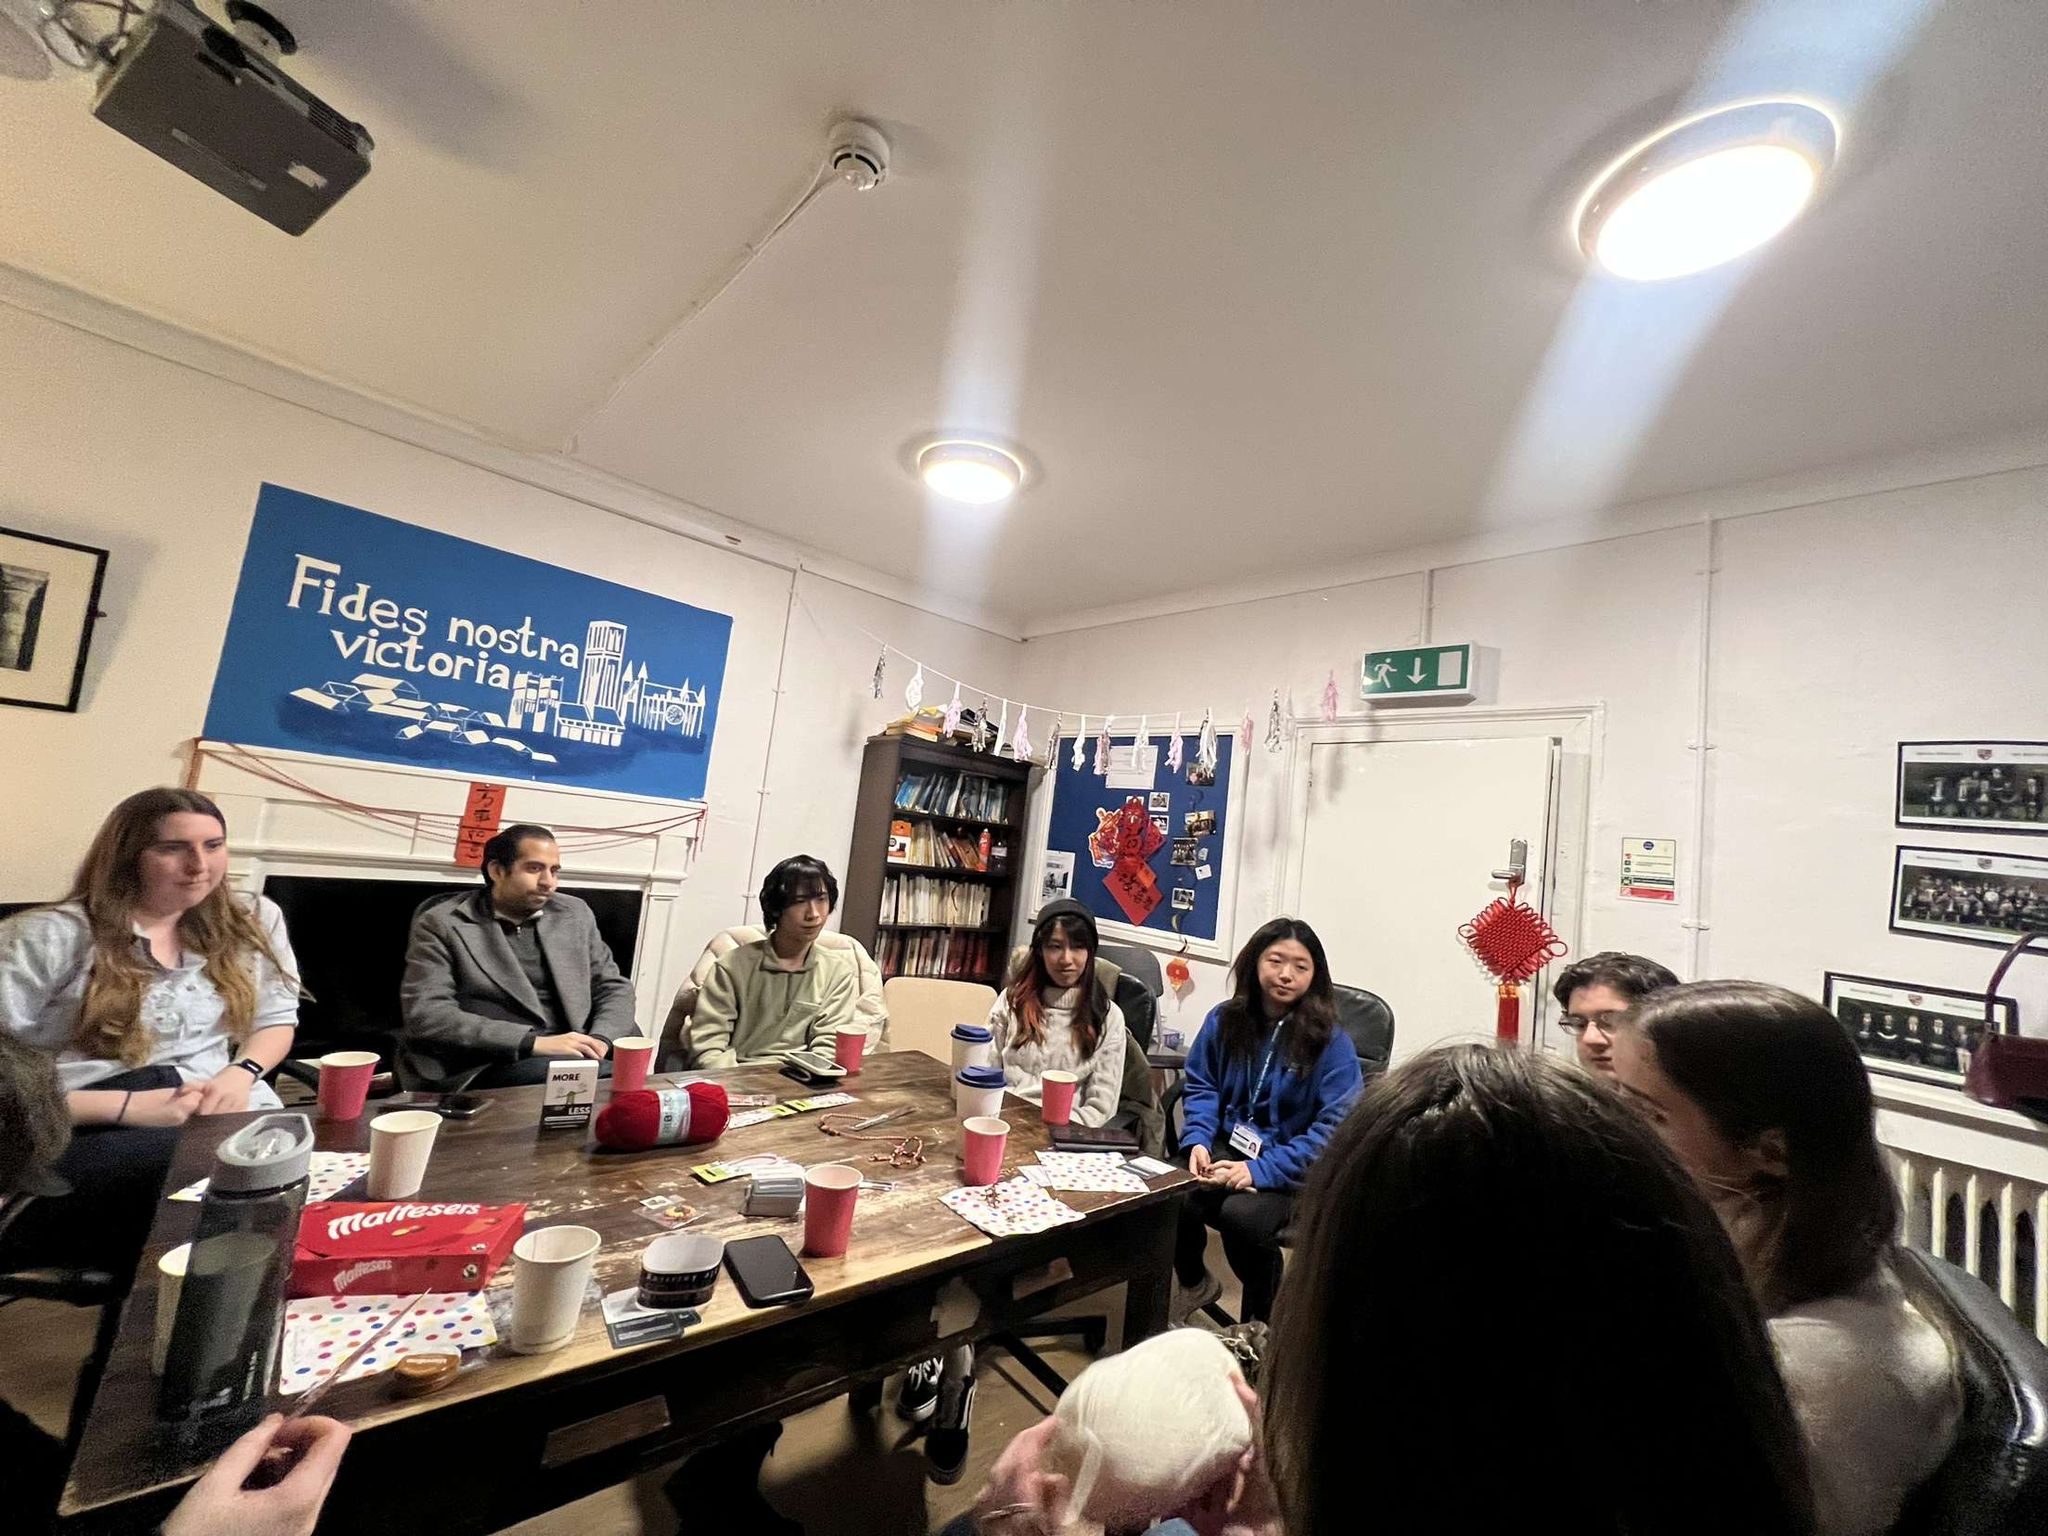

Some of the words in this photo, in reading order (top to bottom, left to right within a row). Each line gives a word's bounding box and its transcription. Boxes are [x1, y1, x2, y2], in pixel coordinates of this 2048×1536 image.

[287, 553, 429, 636] Fides
[446, 616, 579, 670] nostra
[330, 629, 511, 690] victoria
[552, 1073, 580, 1081] MORE
[568, 1107, 590, 1115] LESS
[327, 1203, 481, 1240] Maltesers
[333, 1259, 393, 1293] Maltesers
